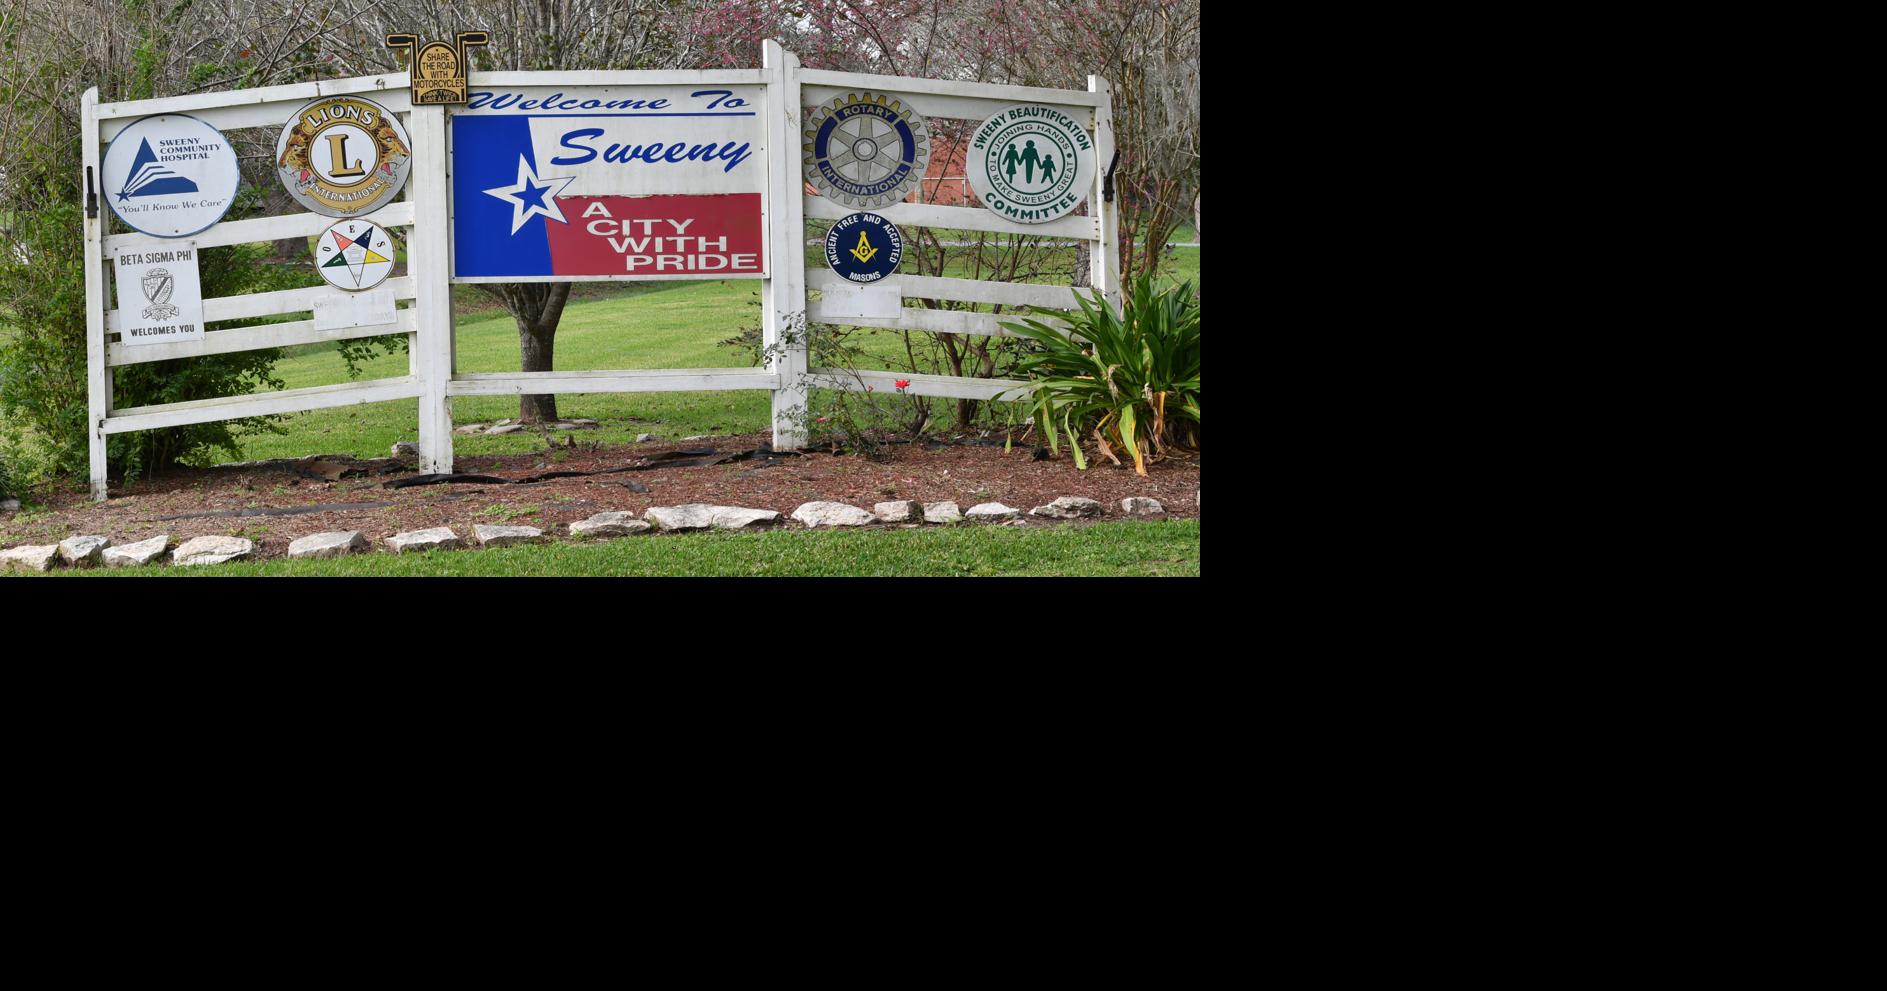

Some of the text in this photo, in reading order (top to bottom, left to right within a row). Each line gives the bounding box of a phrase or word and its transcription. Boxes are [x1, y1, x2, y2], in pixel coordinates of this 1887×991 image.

[427, 53, 449, 61] SHARE
[422, 62, 455, 70] THE ROAD
[414, 80, 464, 88] MOTORCYCLES
[467, 92, 672, 110] Welcome
[691, 90, 750, 109] To
[307, 105, 374, 128] LIONS
[843, 106, 894, 119] ROTARY
[974, 106, 1091, 151] SWEENY BEAUTIFICATION
[160, 138, 200, 146] SWEENY
[996, 124, 1069, 150] JOINING HANDS
[160, 144, 221, 154] COMMUNITY
[160, 152, 210, 162] HOSPITAL
[325, 134, 365, 178] L
[550, 128, 752, 173] Sweeny
[822, 166, 908, 194] INTERNATIONAL
[990, 160, 1073, 203] TO MAKE SWEENY GREAT
[309, 179, 385, 201] INTERNATIONAL
[153, 203, 178, 211] Know
[582, 202, 612, 218] A
[985, 192, 1077, 220] COMMITTEE
[349, 225, 355, 233] E
[587, 219, 695, 236] CITY
[607, 236, 727, 253] WITH
[828, 214, 900, 266] ANCIENT FREE AND ACCEPTED
[121, 250, 192, 265] BETA SIGMA PHI
[860, 245, 868, 256] G
[626, 254, 758, 271] PRIDE
[849, 271, 881, 282] MASONS
[131, 324, 194, 336] WELCOMES YOU
